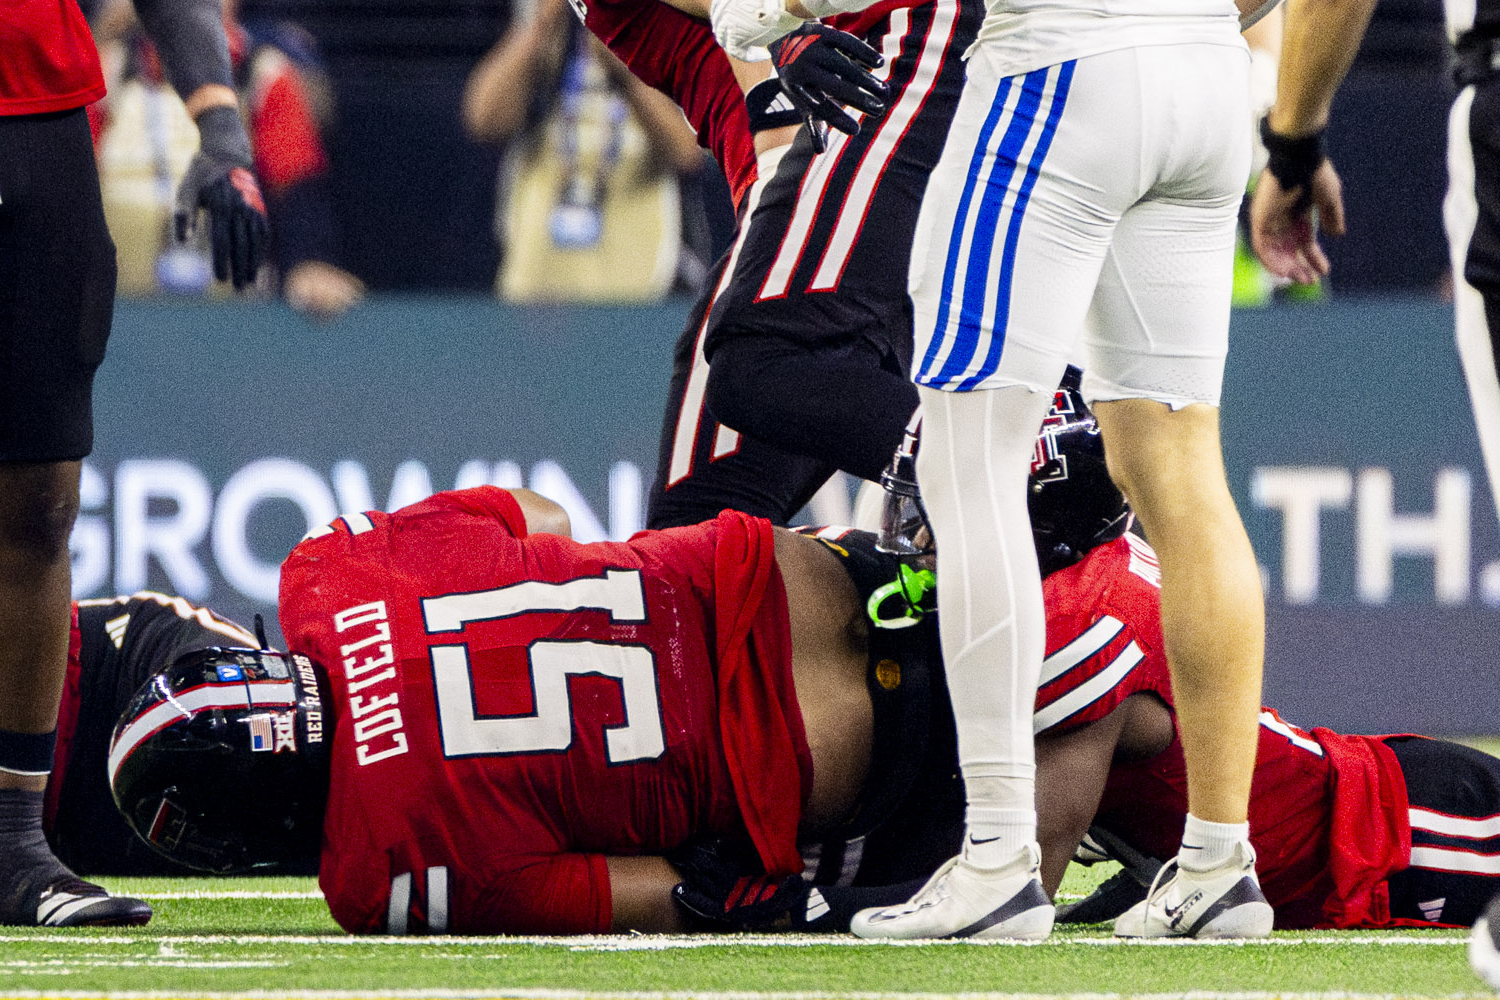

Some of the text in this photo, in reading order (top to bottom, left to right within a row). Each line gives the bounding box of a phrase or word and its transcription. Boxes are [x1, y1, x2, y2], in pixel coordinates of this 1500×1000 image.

[292, 654, 323, 744] RED RAIDERS
[334, 600, 409, 766] COFIELD
[419, 567, 674, 768] 15
